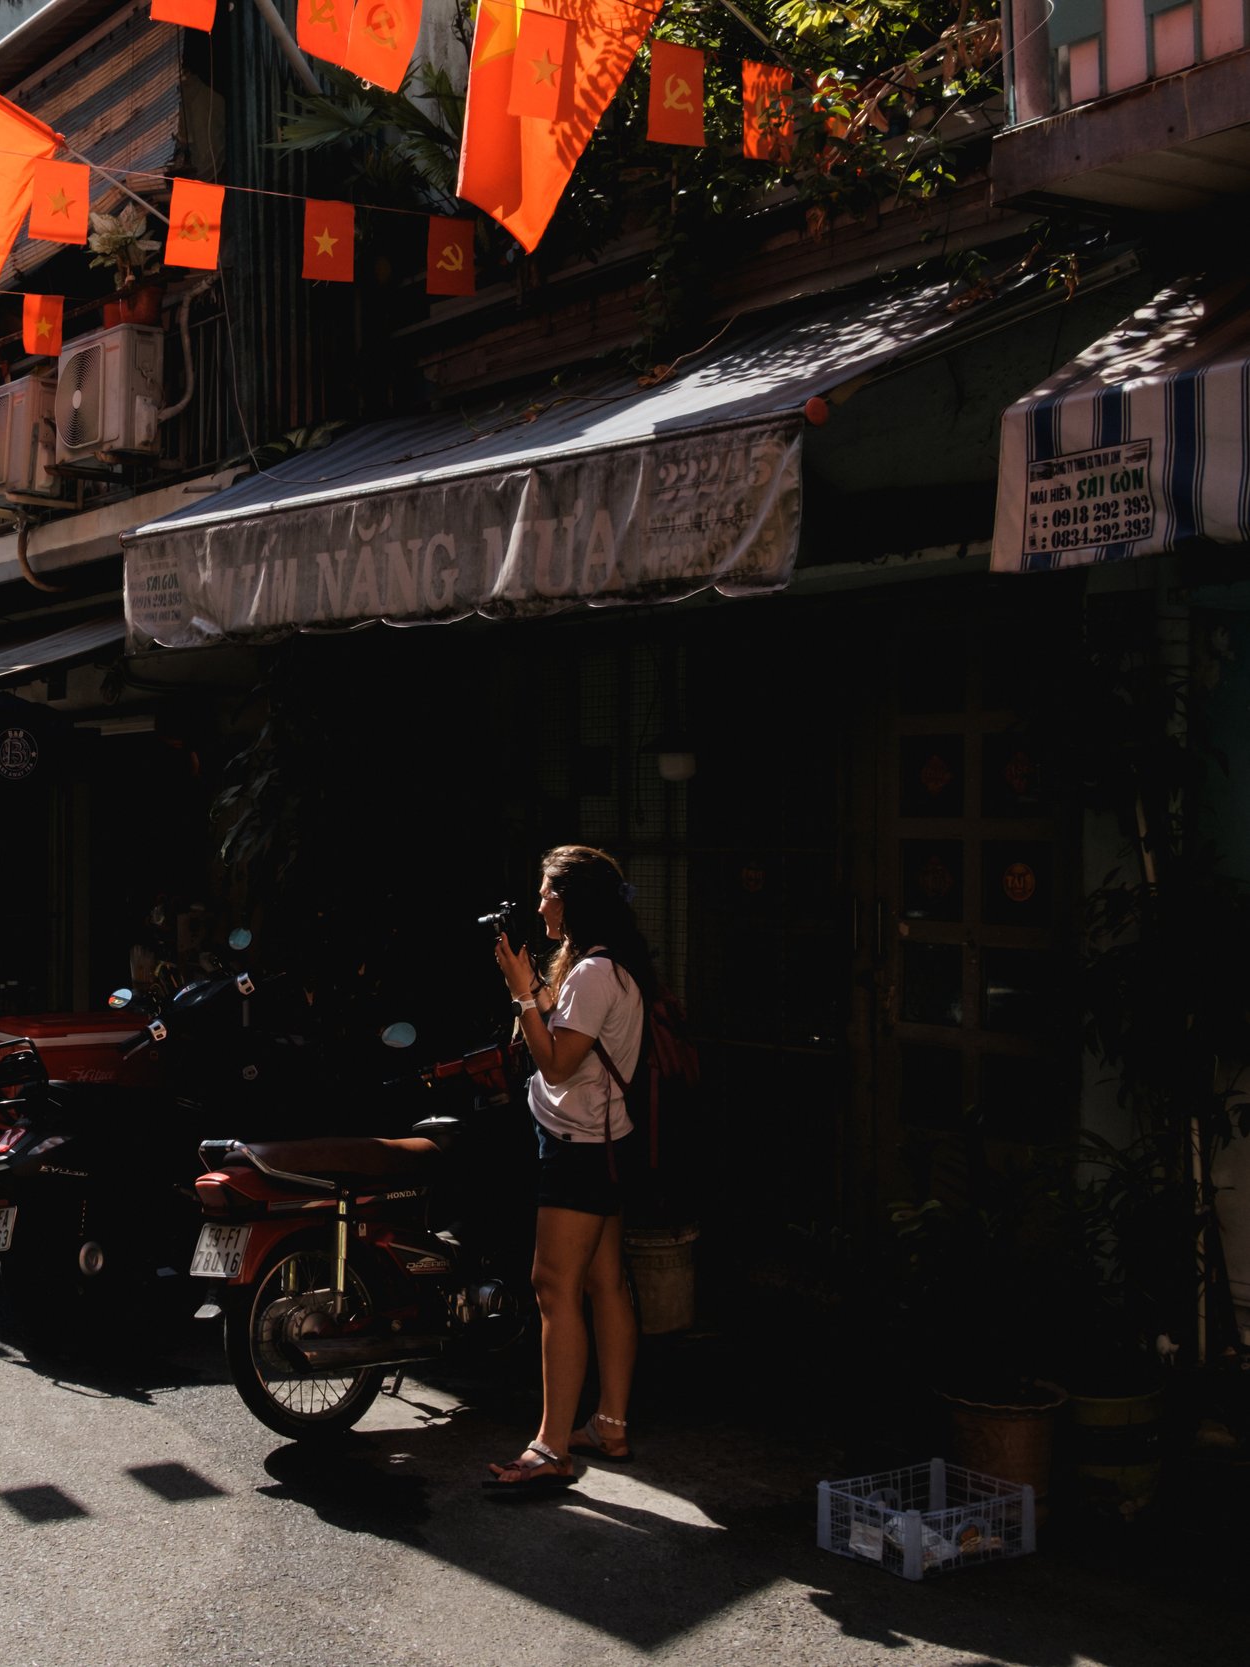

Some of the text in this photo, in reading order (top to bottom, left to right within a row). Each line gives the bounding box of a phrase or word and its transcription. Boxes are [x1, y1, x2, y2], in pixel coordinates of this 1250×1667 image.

[1030, 487, 1047, 505] MÁI
[1077, 472, 1105, 500] SÀI
[1110, 466, 1144, 494] GÒN
[1052, 505, 1089, 527] 0918
[1093, 500, 1120, 521] 292
[1124, 495, 1150, 517] 393
[314, 512, 459, 619] NẮNG
[481, 499, 626, 600] MƯA
[385, 1189, 418, 1201] HONDA
[205, 1227, 241, 1249] 59-F1
[194, 1251, 241, 1273] 780.16
